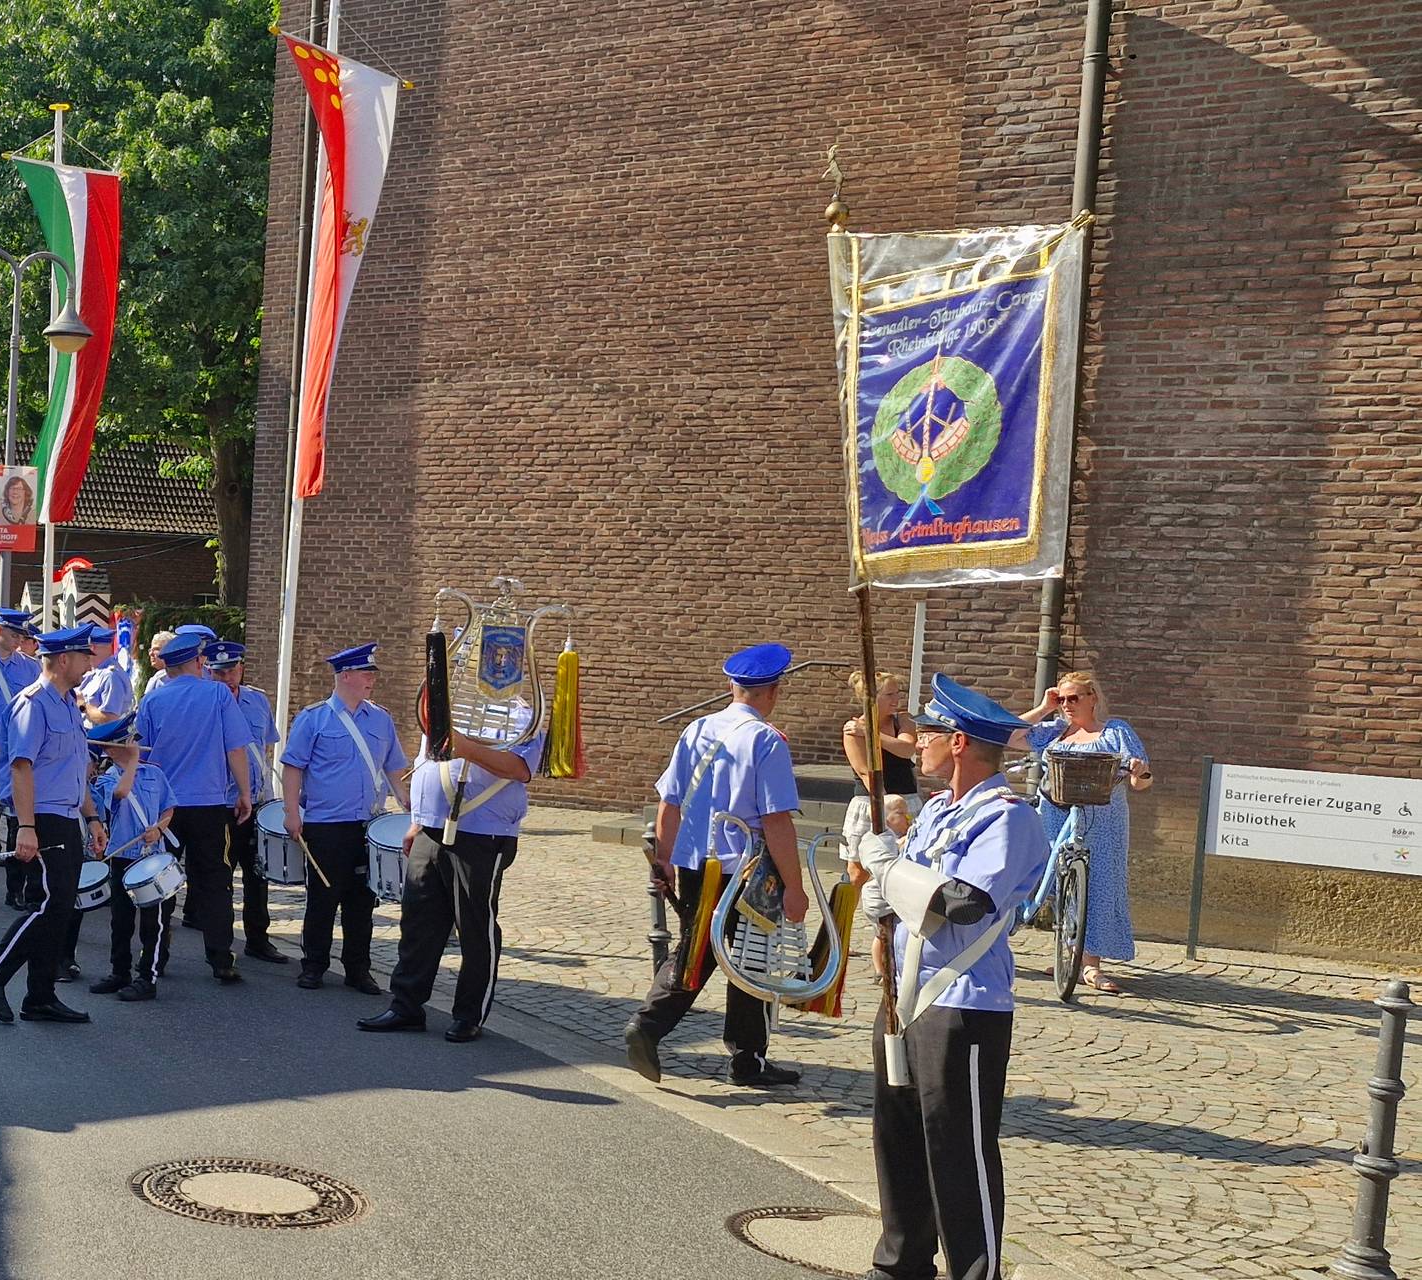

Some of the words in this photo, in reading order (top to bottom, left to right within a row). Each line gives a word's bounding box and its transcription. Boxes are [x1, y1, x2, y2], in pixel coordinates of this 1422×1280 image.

[863, 289, 1045, 338] renadier-Tambour-Corps
[1225, 788, 1323, 808] Barrierefreier
[1325, 797, 1382, 815] Zugang
[1223, 811, 1296, 829] Bibliothek
[1220, 833, 1250, 848] Kita
